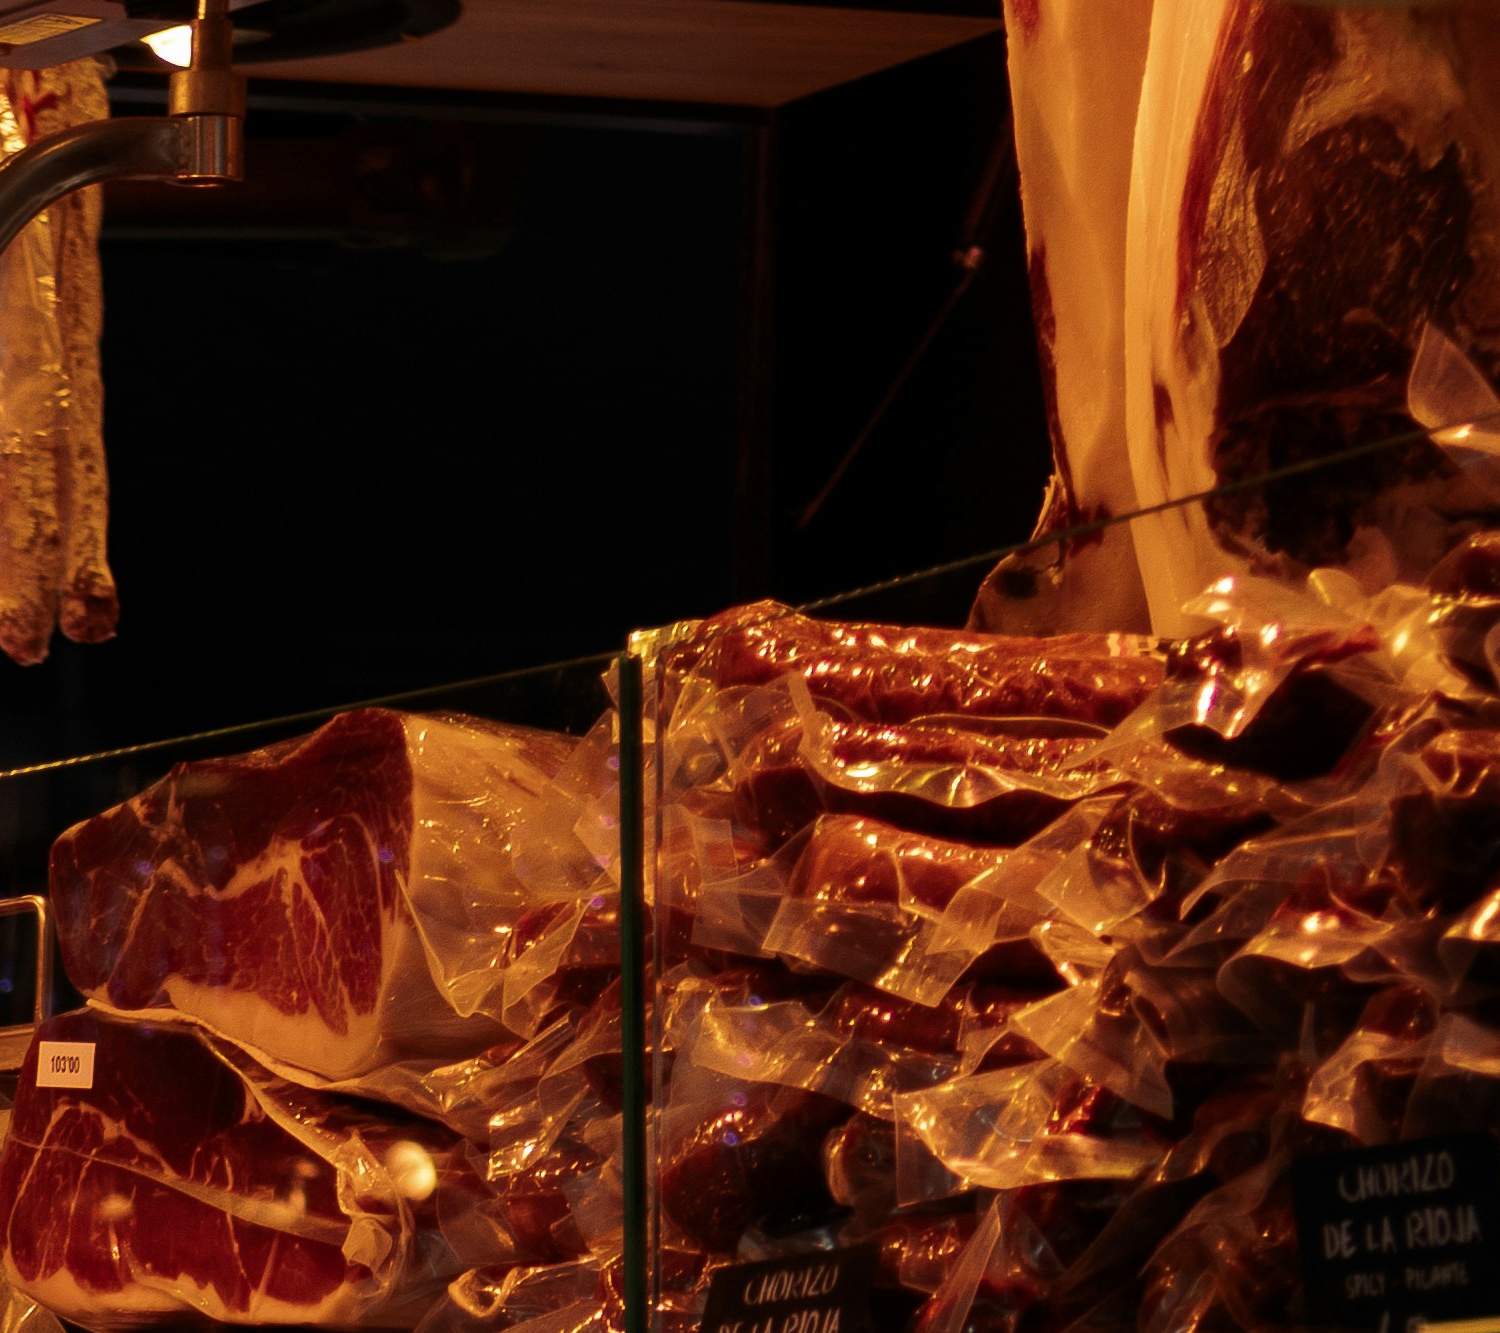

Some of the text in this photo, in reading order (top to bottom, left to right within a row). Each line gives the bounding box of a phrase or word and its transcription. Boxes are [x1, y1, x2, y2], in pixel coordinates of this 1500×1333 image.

[51, 1056, 80, 1074] 103'00
[1337, 1150, 1456, 1203] CHORIZO
[1323, 1203, 1483, 1260] DE LA RIOJA
[743, 1263, 840, 1306] CHORIZO
